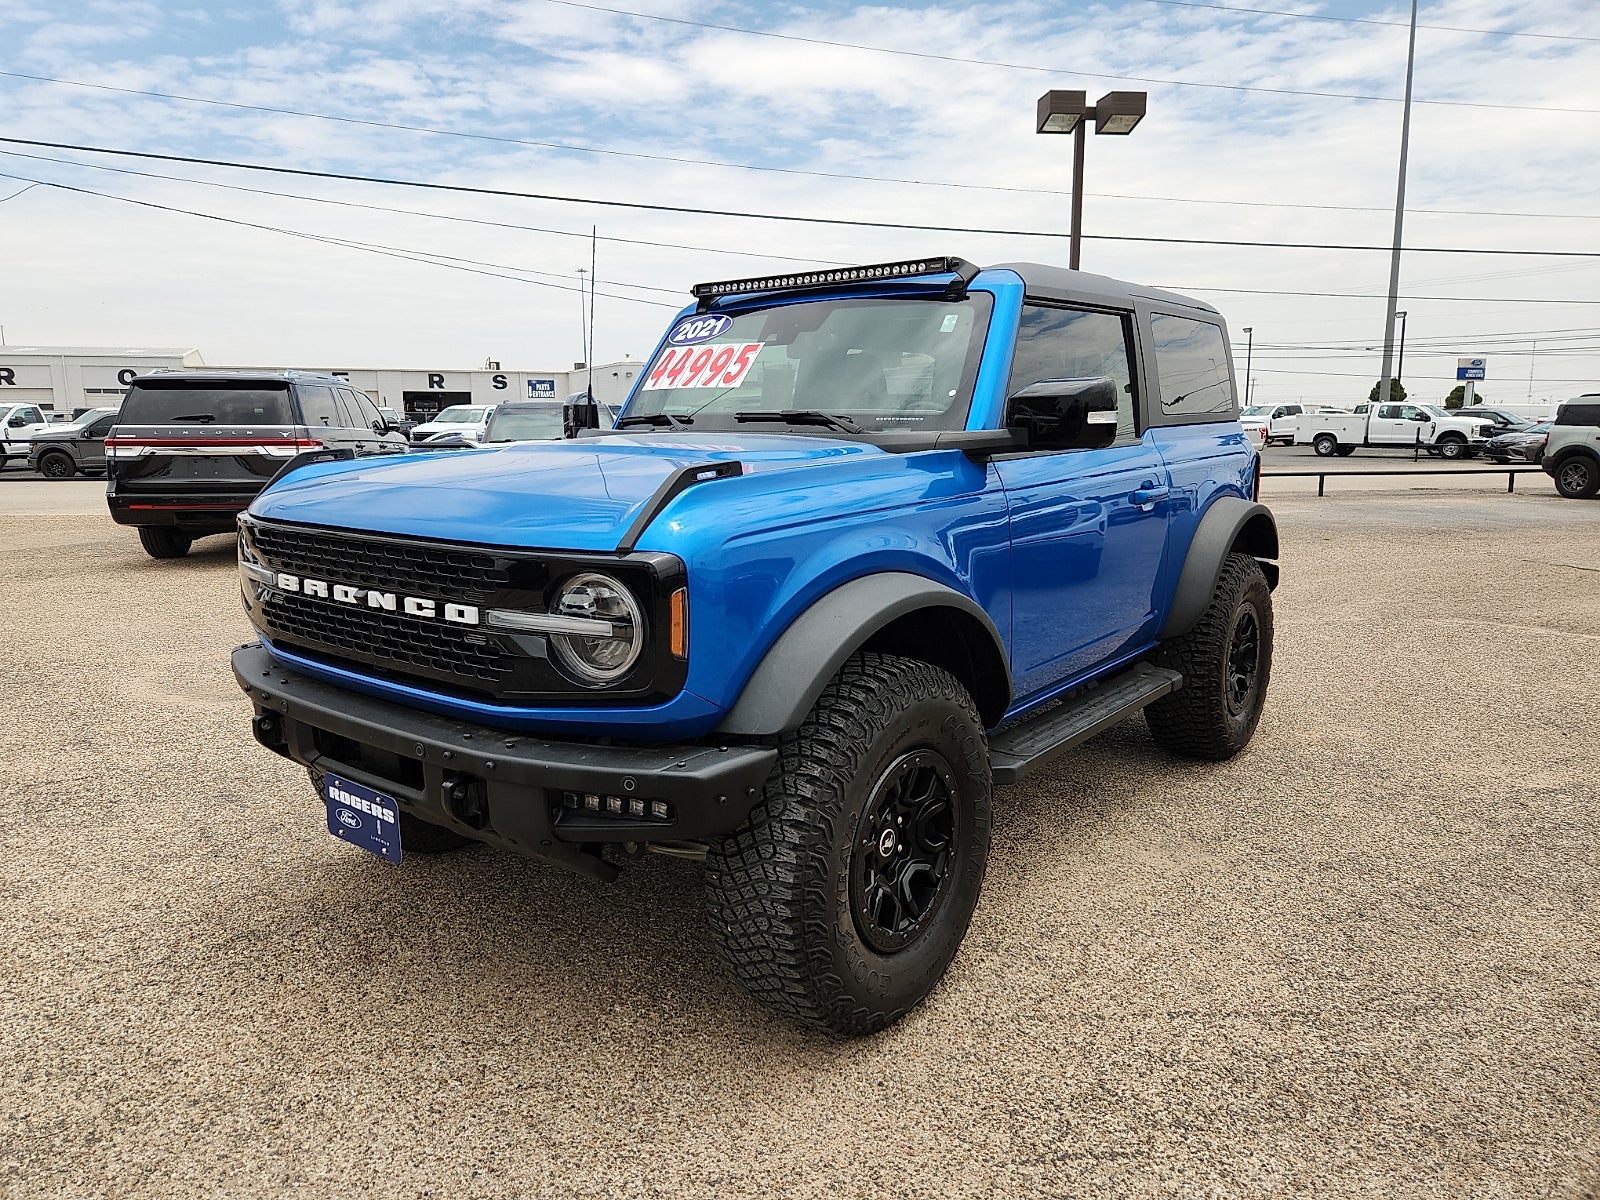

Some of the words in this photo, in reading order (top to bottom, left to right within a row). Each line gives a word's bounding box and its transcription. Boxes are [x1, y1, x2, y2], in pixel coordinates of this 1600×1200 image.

[673, 317, 727, 342] 2021
[650, 344, 760, 387] 44995
[532, 390, 556, 398] ENTRANCE
[535, 383, 551, 391] PARTS
[277, 573, 479, 625] BRONCO
[328, 785, 395, 824] ROGERS
